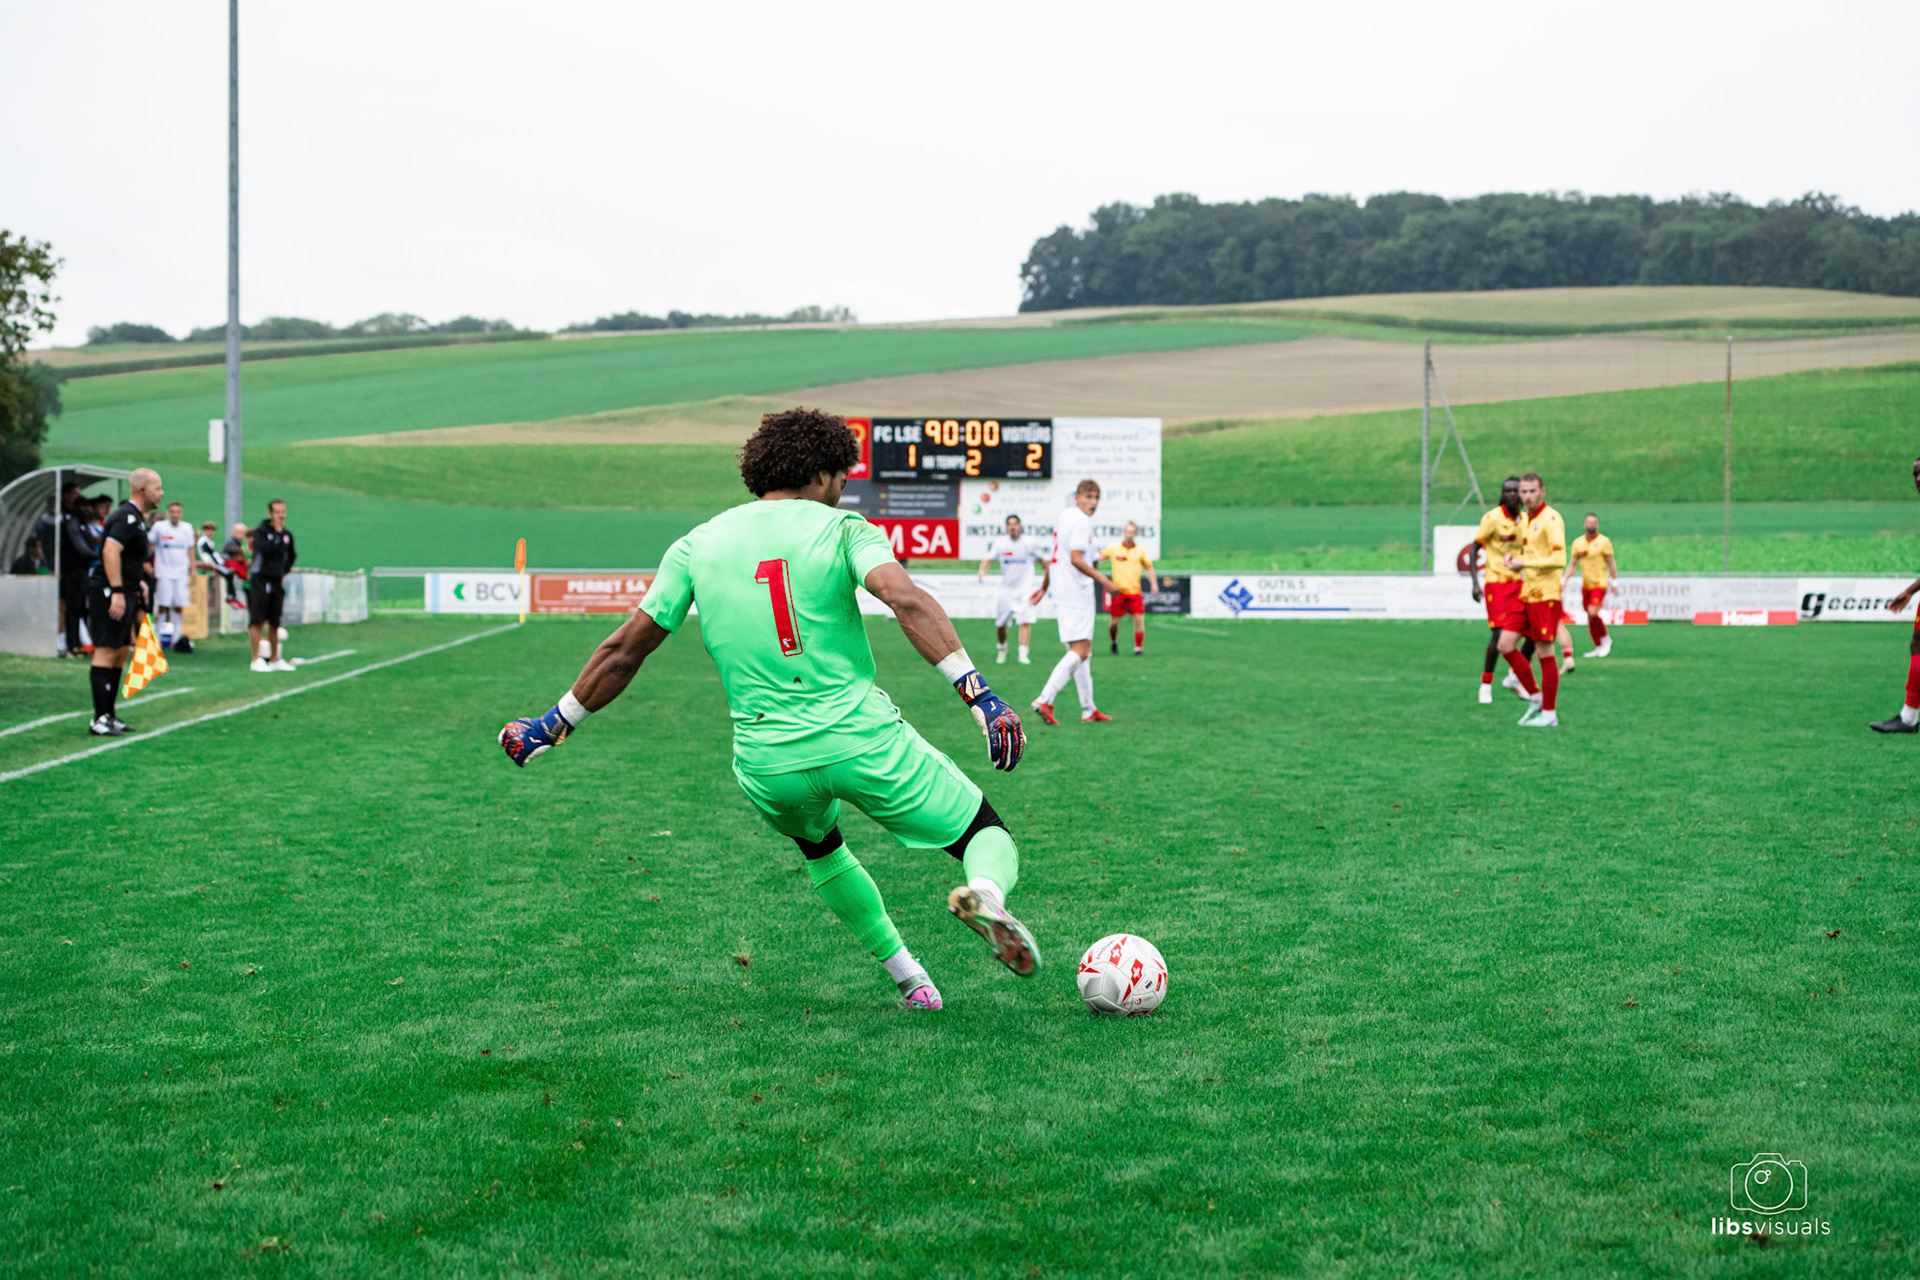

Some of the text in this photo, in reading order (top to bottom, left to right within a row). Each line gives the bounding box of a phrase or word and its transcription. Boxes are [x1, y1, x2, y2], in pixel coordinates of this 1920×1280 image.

[874, 426, 922, 443] FC LSE
[925, 419, 1000, 447] 90:00
[908, 444, 916, 468] 1
[965, 449, 982, 476] 2
[1026, 443, 1043, 470] 2
[911, 524, 952, 554] SA
[476, 583, 521, 600] BCV
[567, 580, 647, 593] PERRET SA
[1258, 579, 1306, 590] OUTILS
[1617, 582, 1691, 596] omaine
[754, 558, 803, 657] 1
[1258, 592, 1320, 604] SERVICES
